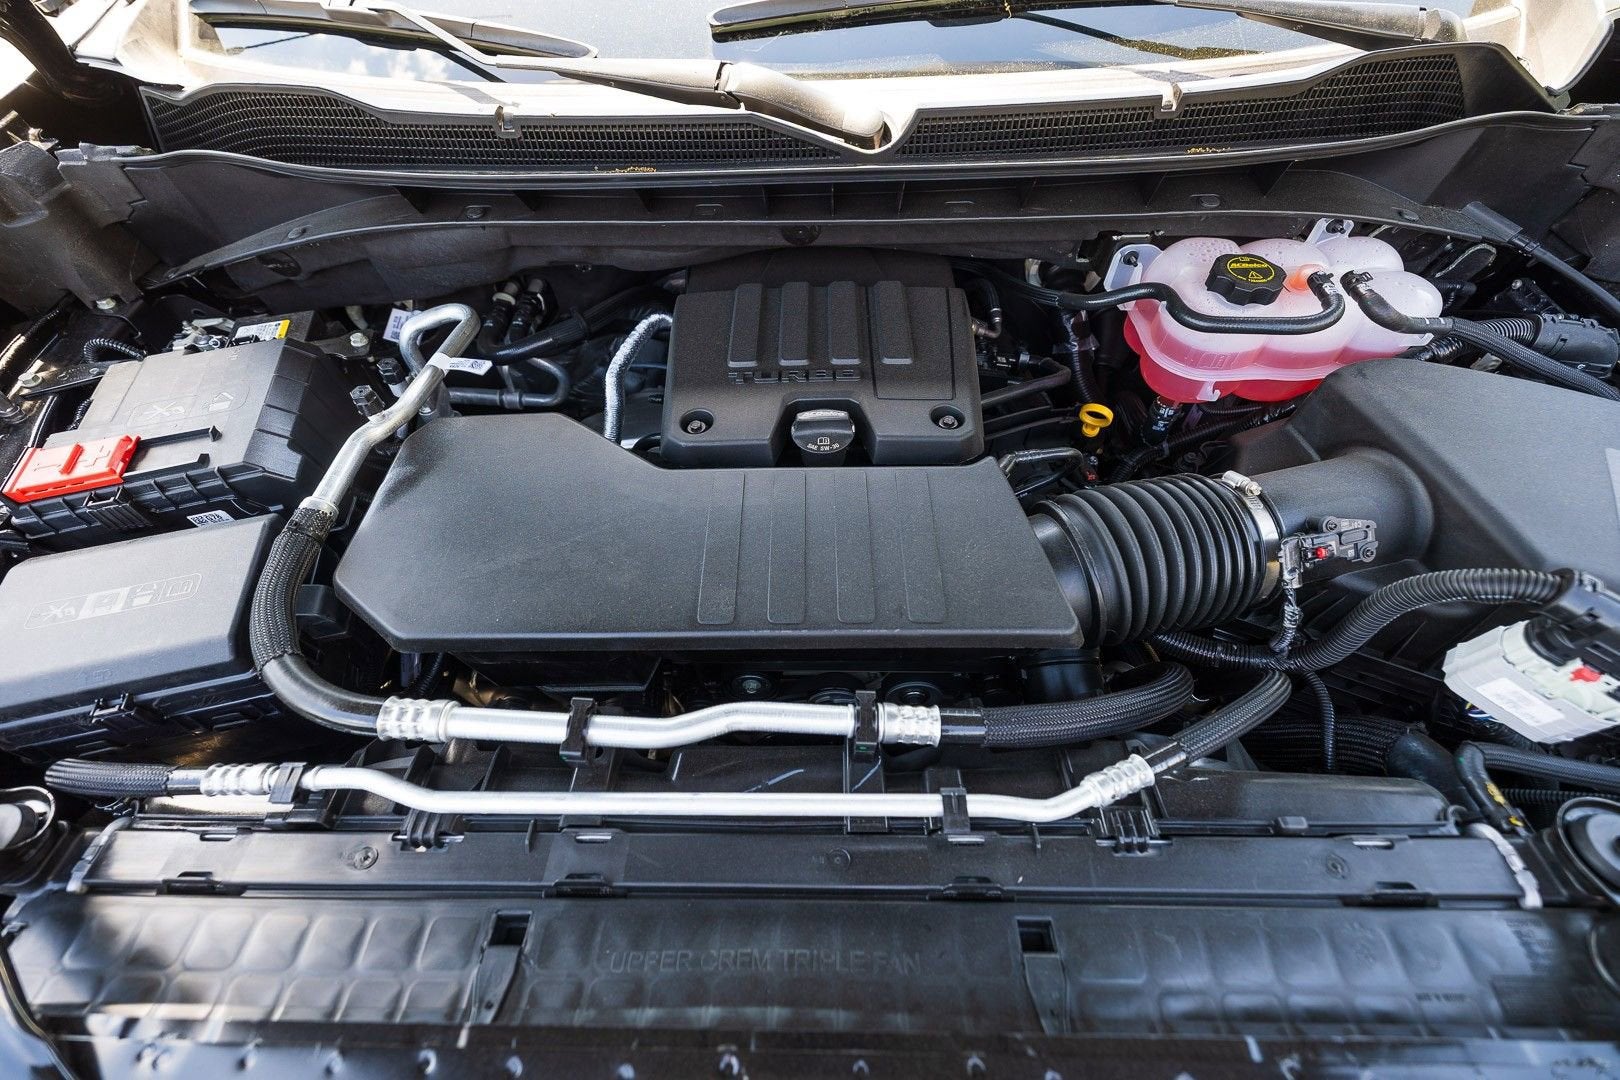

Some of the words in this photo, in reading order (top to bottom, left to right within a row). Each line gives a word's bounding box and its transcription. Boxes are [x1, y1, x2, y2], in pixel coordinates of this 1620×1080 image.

[610, 949, 693, 974] UPPER
[778, 948, 866, 974] TRIPLE
[873, 950, 921, 976] FAN
